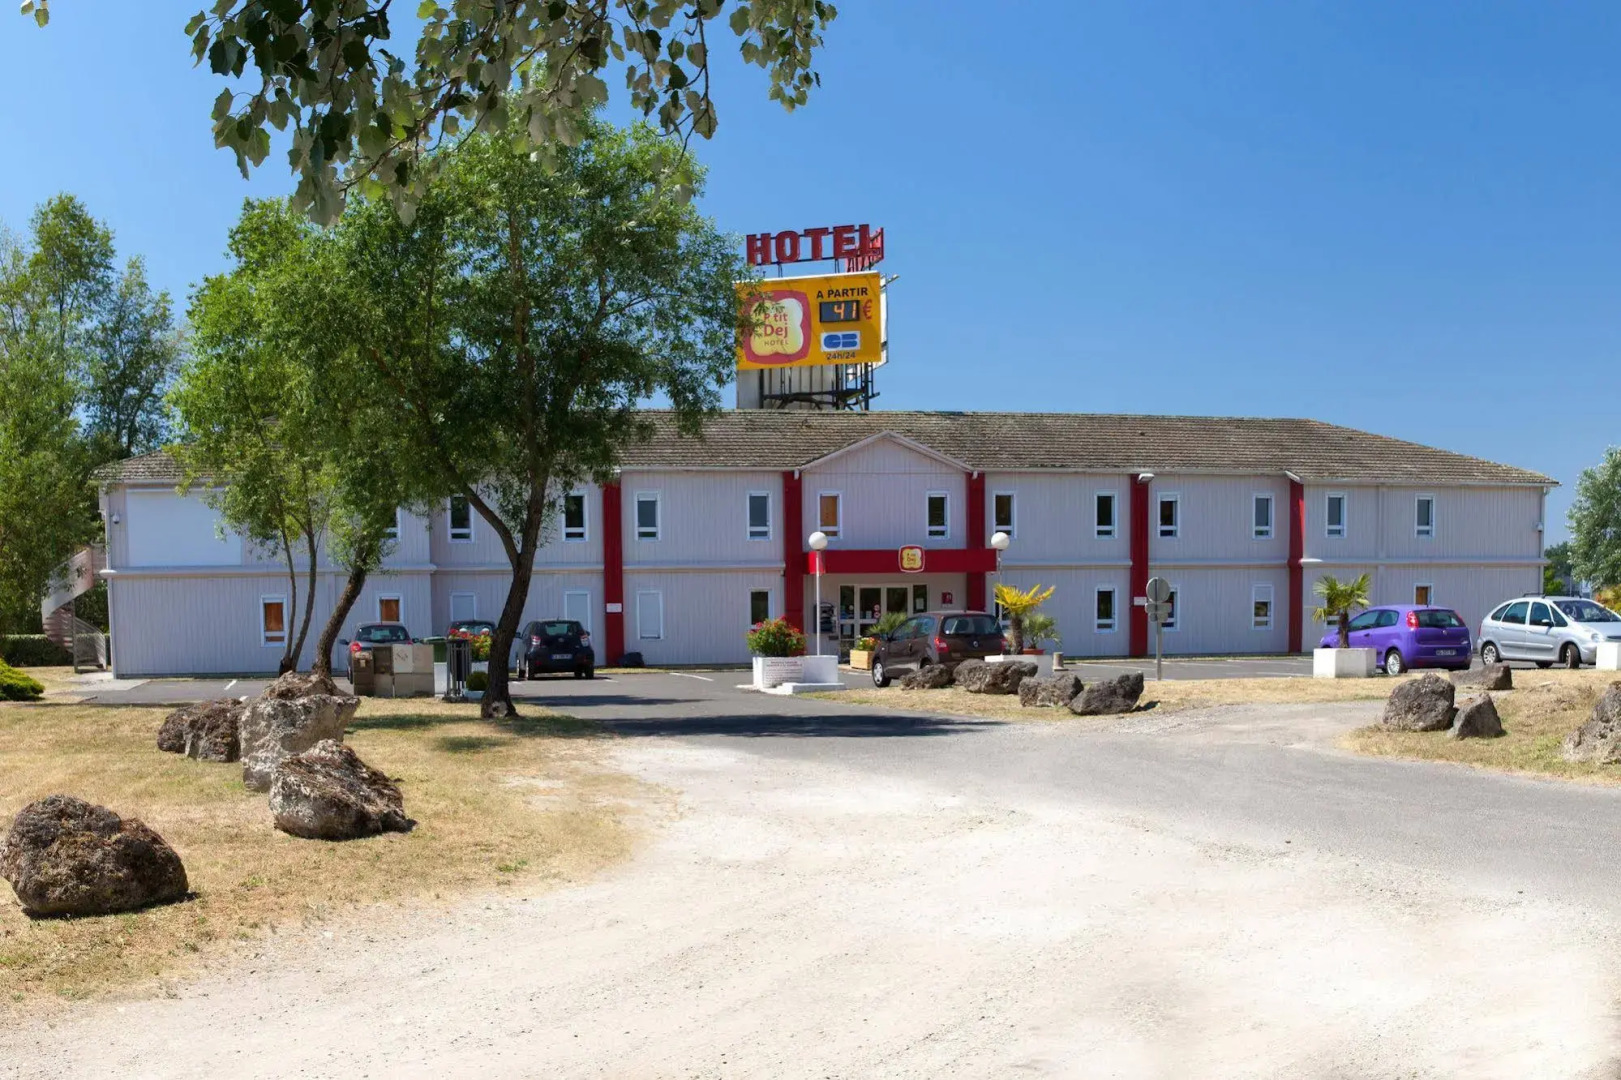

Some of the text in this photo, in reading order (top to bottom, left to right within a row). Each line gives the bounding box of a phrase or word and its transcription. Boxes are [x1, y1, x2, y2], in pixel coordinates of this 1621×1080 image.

[746, 224, 881, 266] HOTEL
[816, 288, 868, 299] A PARTIR
[834, 299, 873, 320] 41 €
[764, 322, 788, 339] Dej
